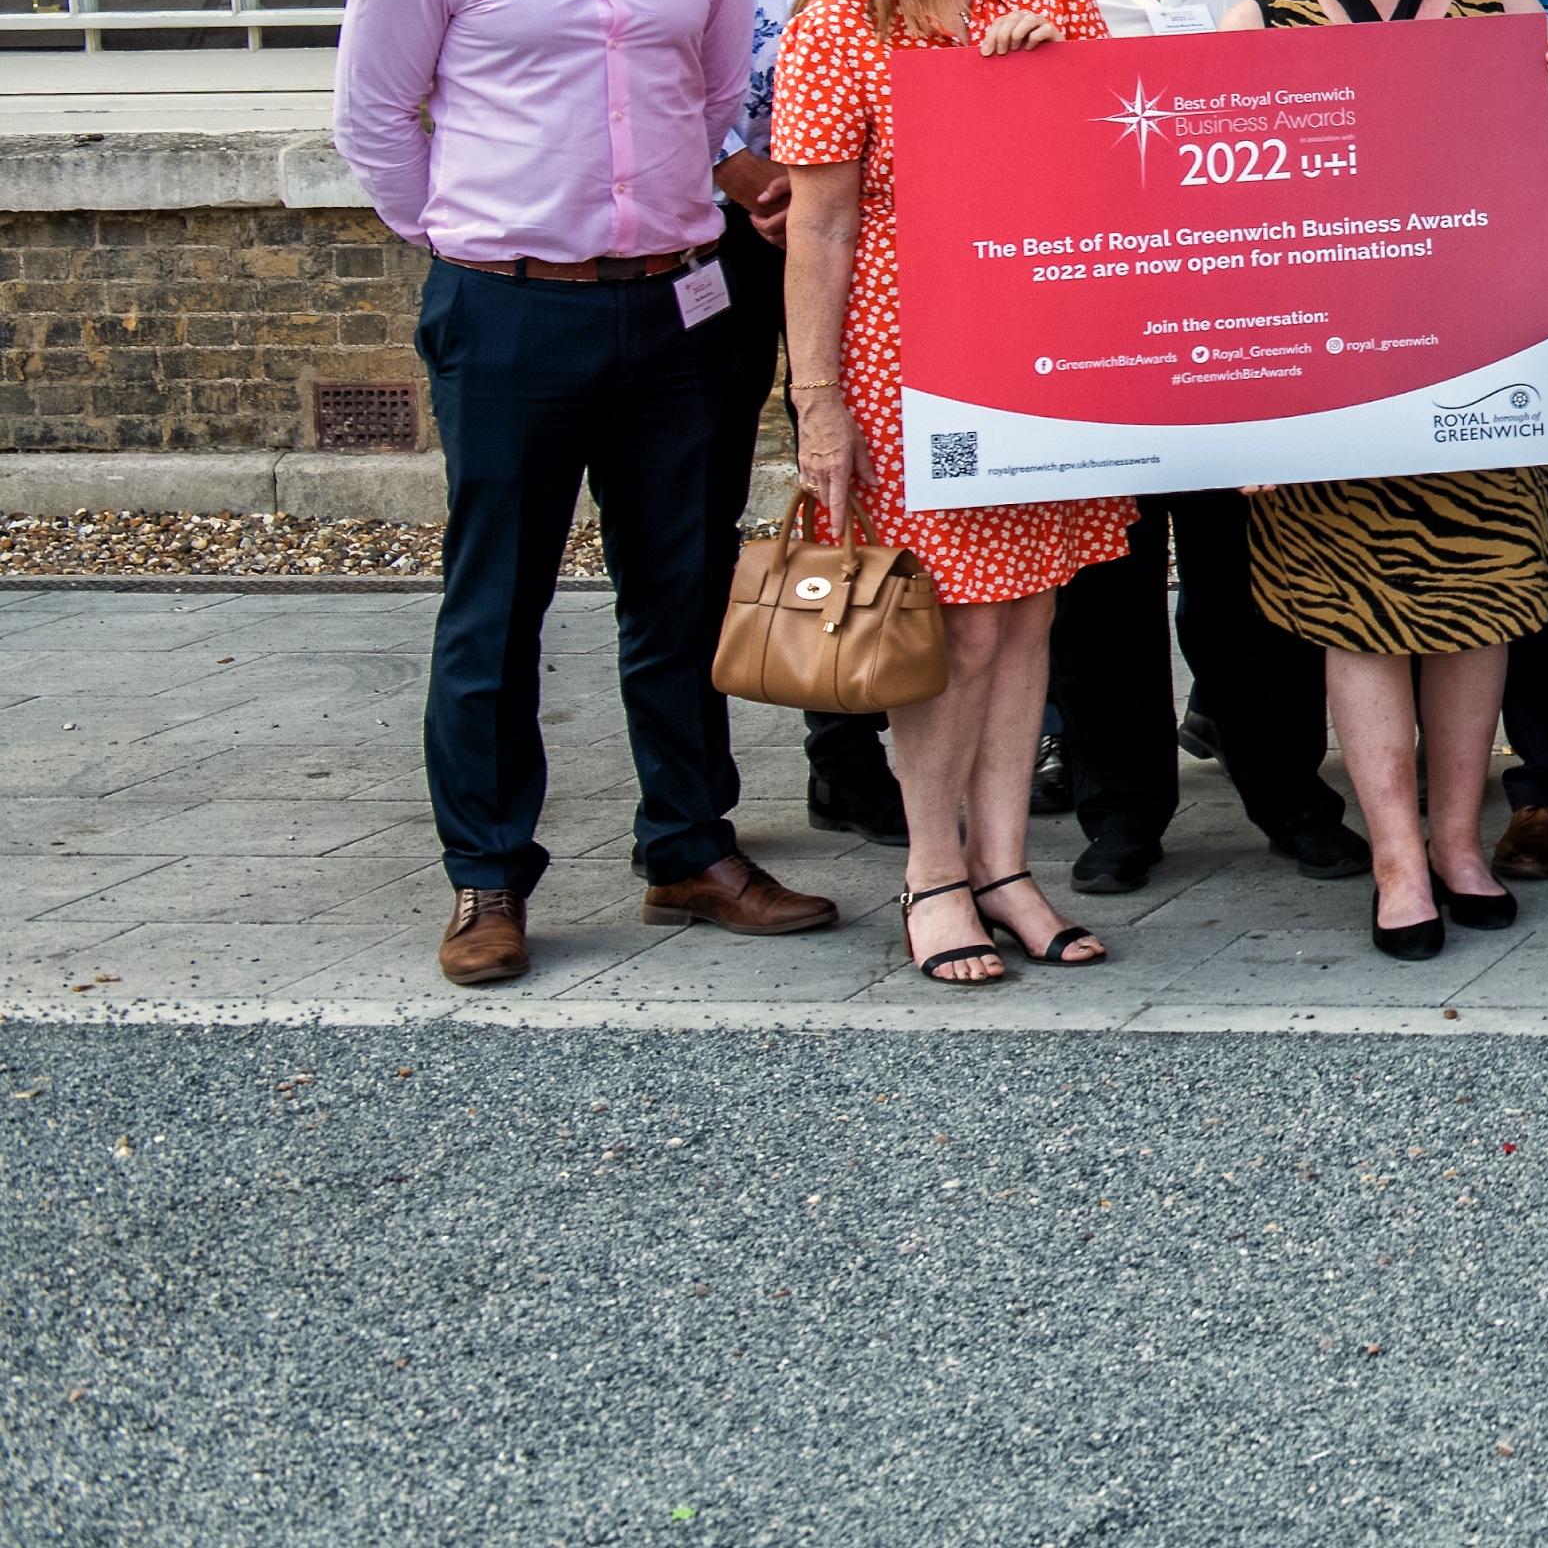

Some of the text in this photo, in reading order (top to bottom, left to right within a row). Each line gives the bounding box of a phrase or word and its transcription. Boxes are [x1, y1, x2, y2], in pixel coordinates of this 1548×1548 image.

[1174, 86, 1356, 111] Best of Royal Greenwich
[1175, 107, 1356, 137] Business Awards
[1178, 138, 1292, 186] 2022
[972, 208, 1489, 259] The Best of Royal Greenwich Business Awards
[1032, 237, 1434, 283] 2022 are now open for nominations!
[1143, 309, 1330, 336] Join the conversation:
[1055, 334, 1439, 372] GreenwichBizAwards Royal_Greenwich royal_greenwich
[1171, 365, 1303, 386] #GreenwichBizAwards
[1433, 410, 1543, 428] ROYAL borough of
[1434, 422, 1545, 443] GREENWICH
[987, 454, 1161, 477] royalgreenwich.gov.uk/businessawards
